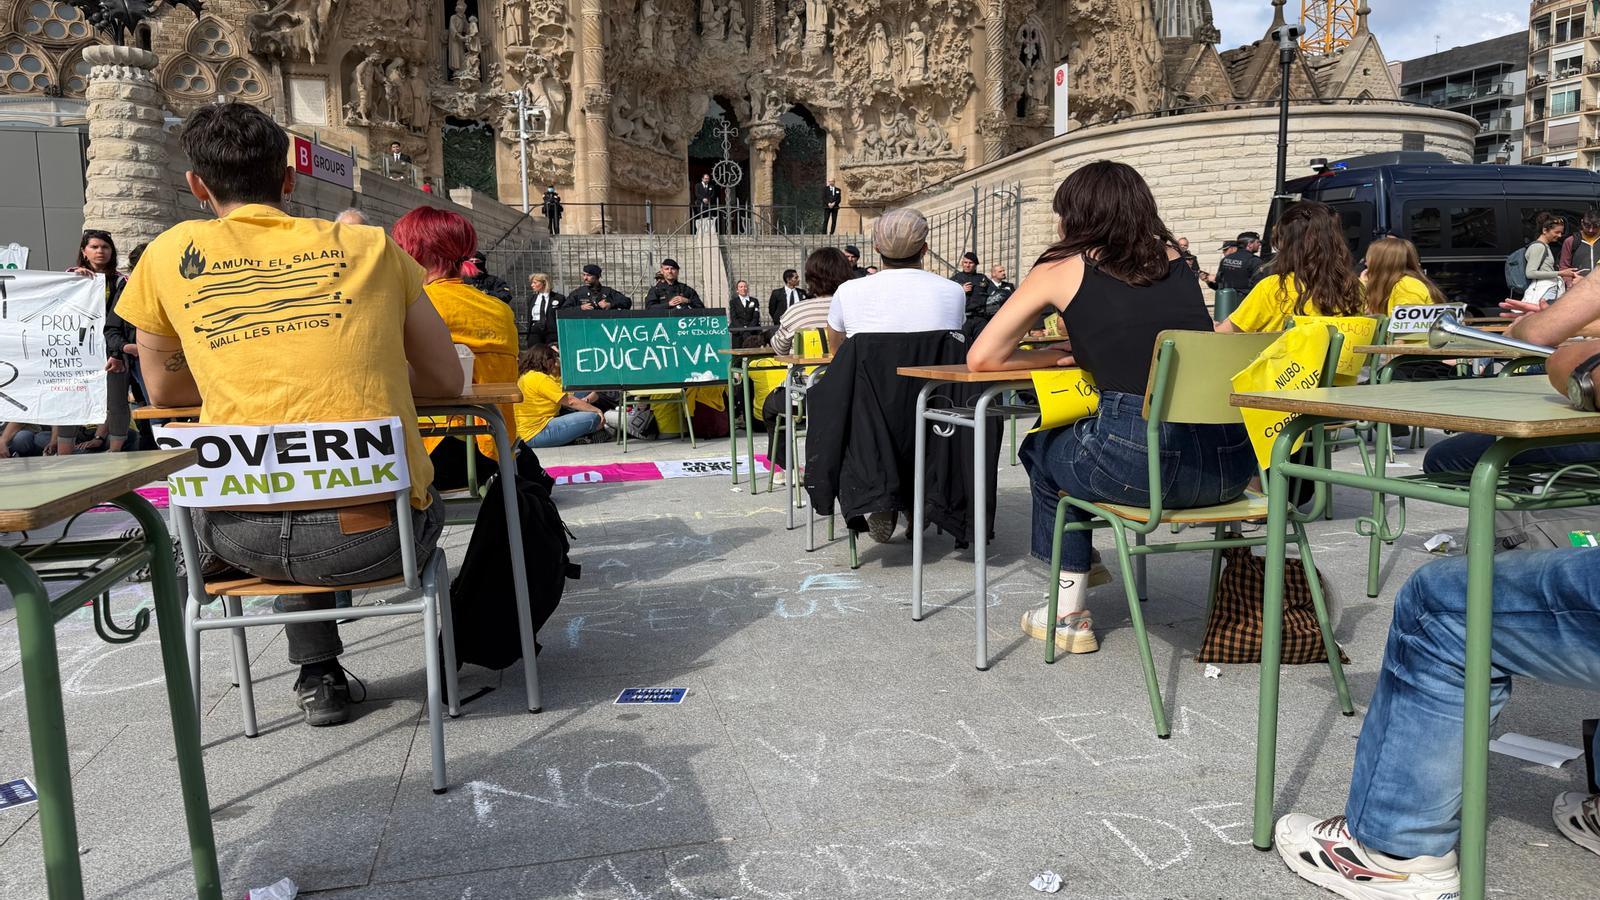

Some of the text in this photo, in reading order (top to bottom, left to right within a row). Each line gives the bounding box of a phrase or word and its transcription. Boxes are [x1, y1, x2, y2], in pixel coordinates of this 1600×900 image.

[300, 147, 345, 176] B GROUPS
[212, 250, 345, 270] AMUNT EL SALARI
[41, 315, 80, 331] PROU
[601, 322, 670, 344] VAGA
[48, 334, 71, 346] DES
[209, 334, 240, 350] AVALL
[244, 326, 271, 340] LES
[50, 358, 82, 368] MENTS
[576, 341, 720, 372] EDUCATIVA
[220, 472, 295, 496] AND
[304, 461, 399, 490] TALK
[463, 761, 673, 827] NO
